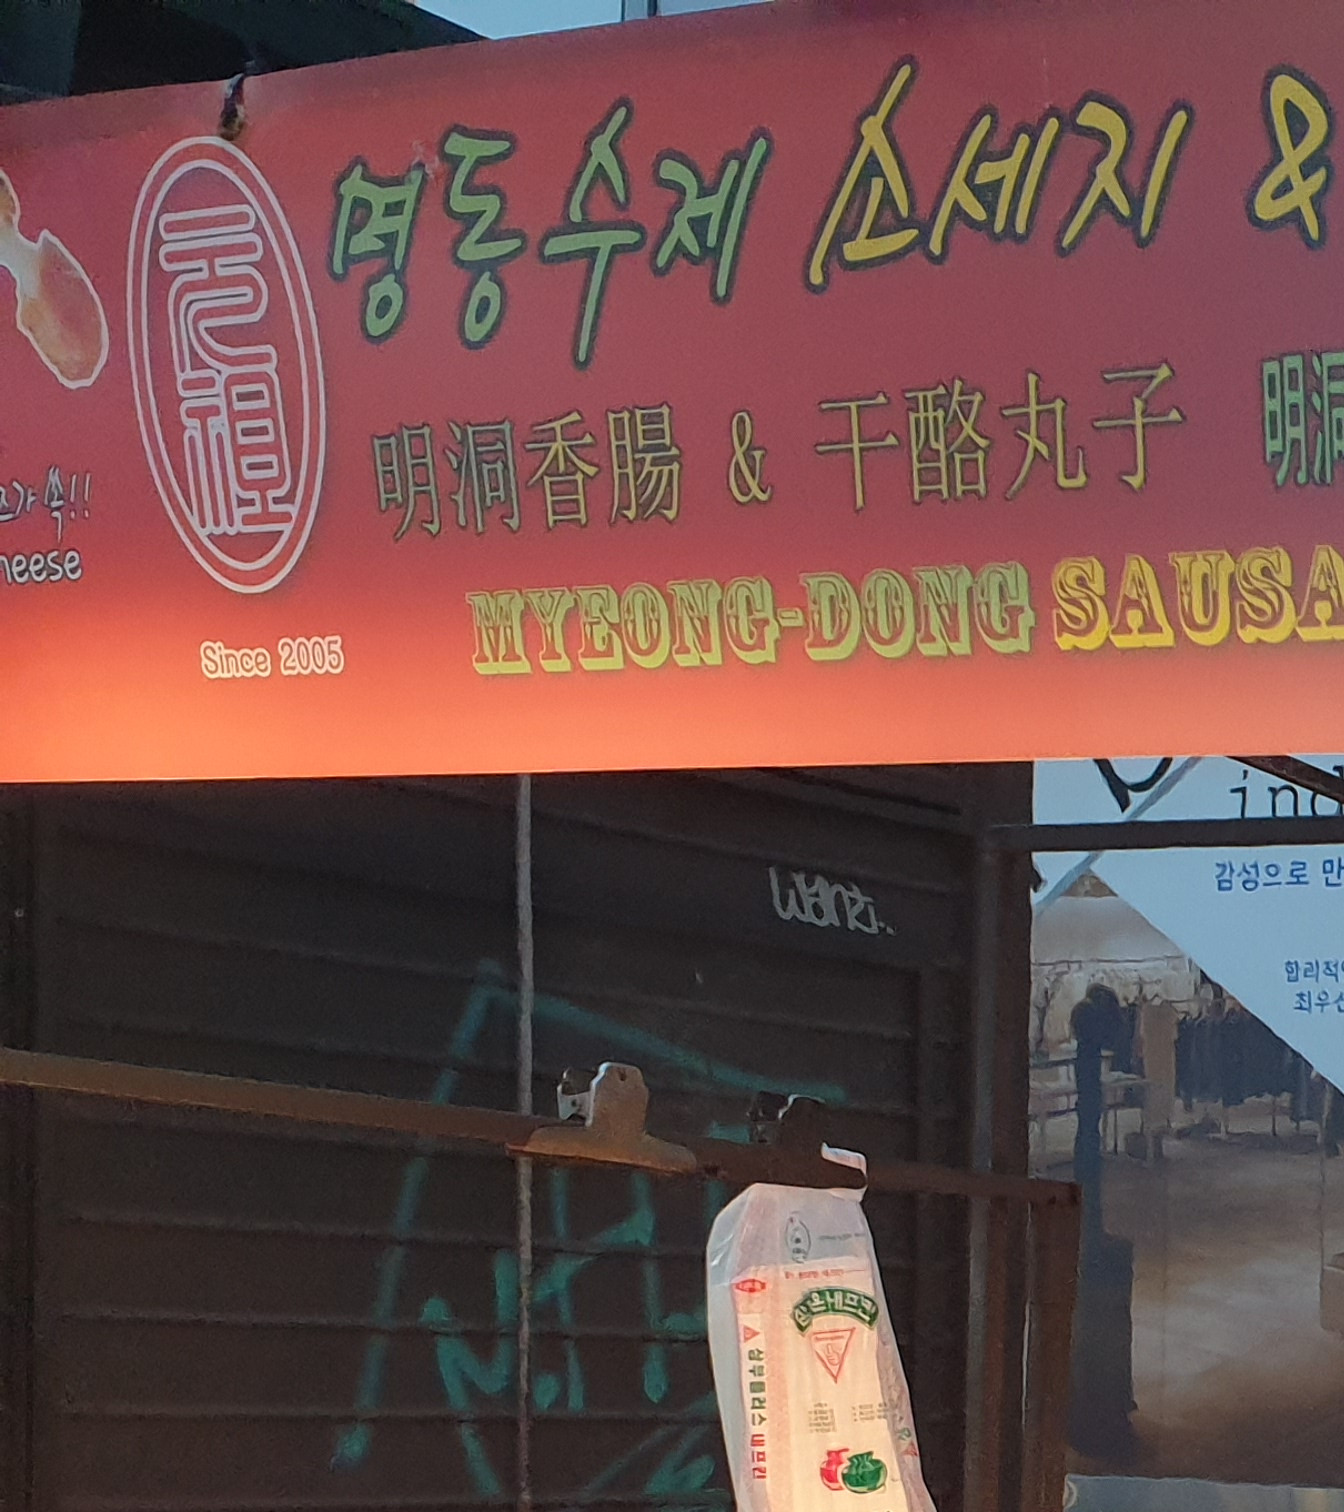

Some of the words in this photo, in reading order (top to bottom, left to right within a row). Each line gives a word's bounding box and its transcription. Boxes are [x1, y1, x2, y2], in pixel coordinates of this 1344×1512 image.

[330, 97, 772, 367] 명동수제
[806, 55, 1194, 292] 소세지
[1250, 66, 1332, 245] &
[373, 403, 681, 540] 明洞香腸
[729, 410, 774, 508] &
[813, 363, 1186, 513] 干酪丸子
[201, 641, 271, 679] Since
[278, 635, 345, 675] 2005
[466, 559, 1035, 676] MYEONG-DONG
[1214, 859, 1310, 894] 감성으로
